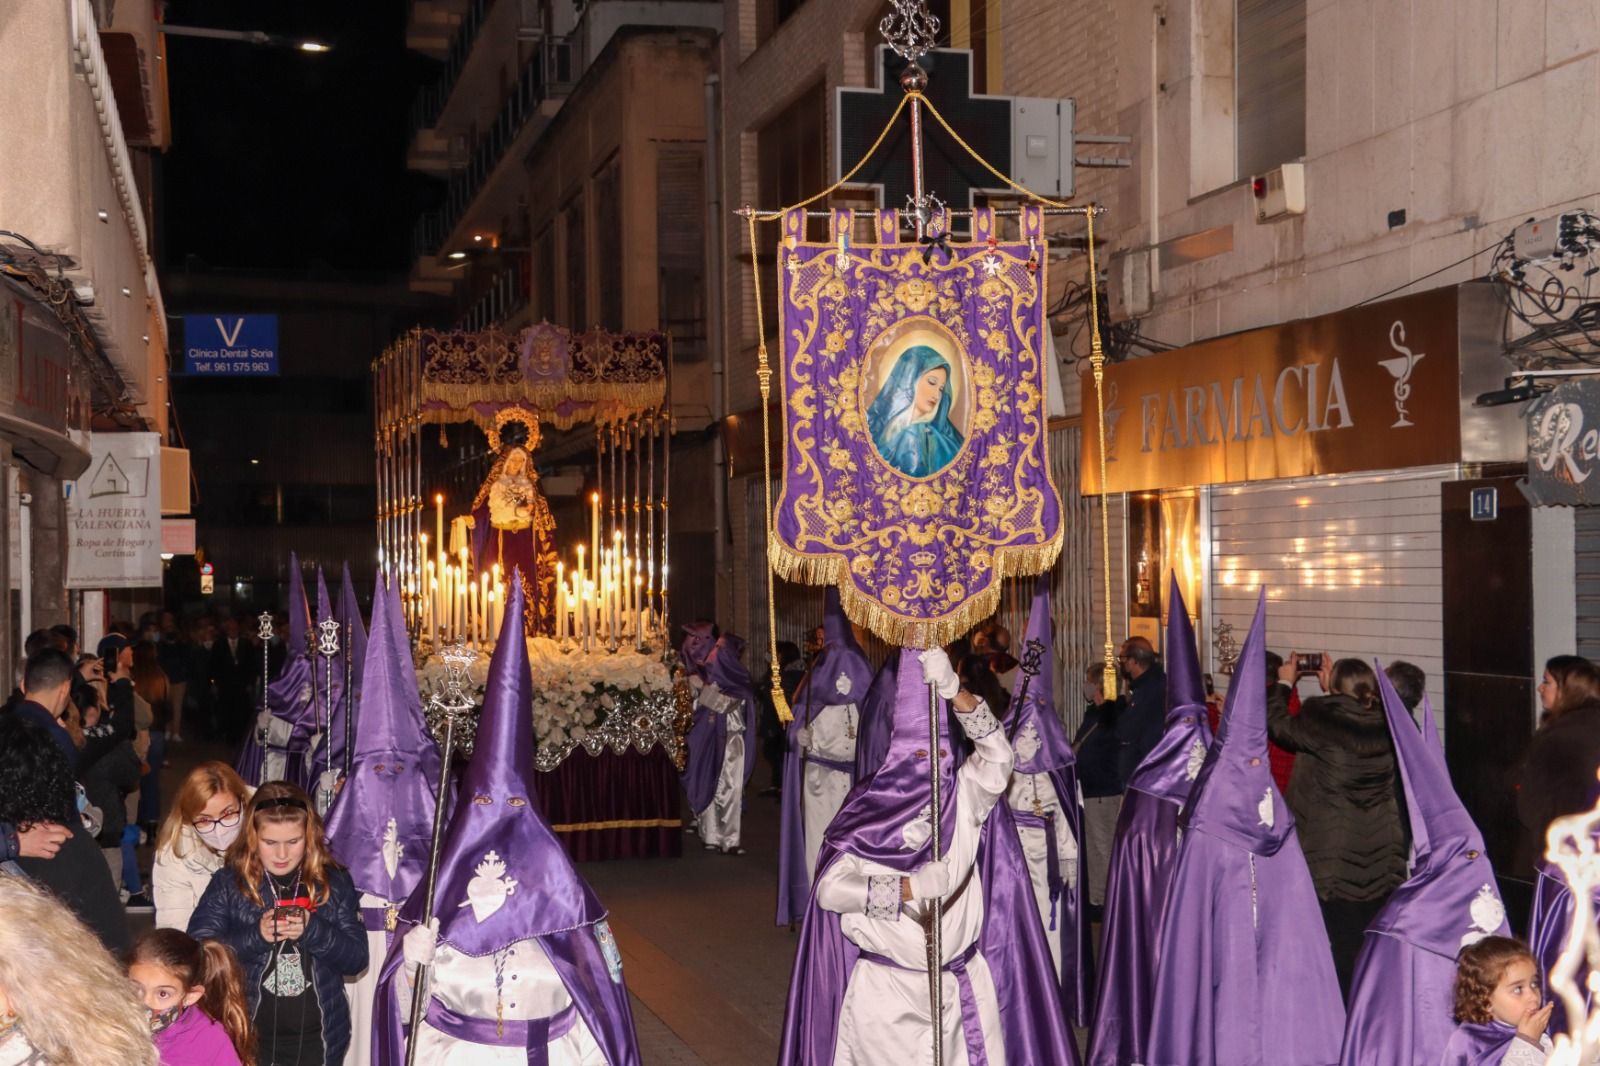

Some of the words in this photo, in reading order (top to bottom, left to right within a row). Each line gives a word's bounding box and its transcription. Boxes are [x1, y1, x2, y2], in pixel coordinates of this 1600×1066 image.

[215, 318, 244, 347] V
[220, 348, 249, 358] Dental
[250, 348, 273, 358] Soria
[214, 362, 231, 372] 961
[233, 362, 250, 372] 575
[252, 362, 269, 372] 963
[1140, 357, 1354, 453] FARMACIA
[1477, 494, 1490, 514] 14
[79, 508, 94, 518] LA
[98, 508, 146, 518] HUERTA
[75, 520, 151, 530] VALENCIANA
[76, 538, 99, 549] Ropa
[102, 538, 113, 547] de
[116, 538, 145, 549] Hogar
[94, 549, 136, 559] Cortinas
